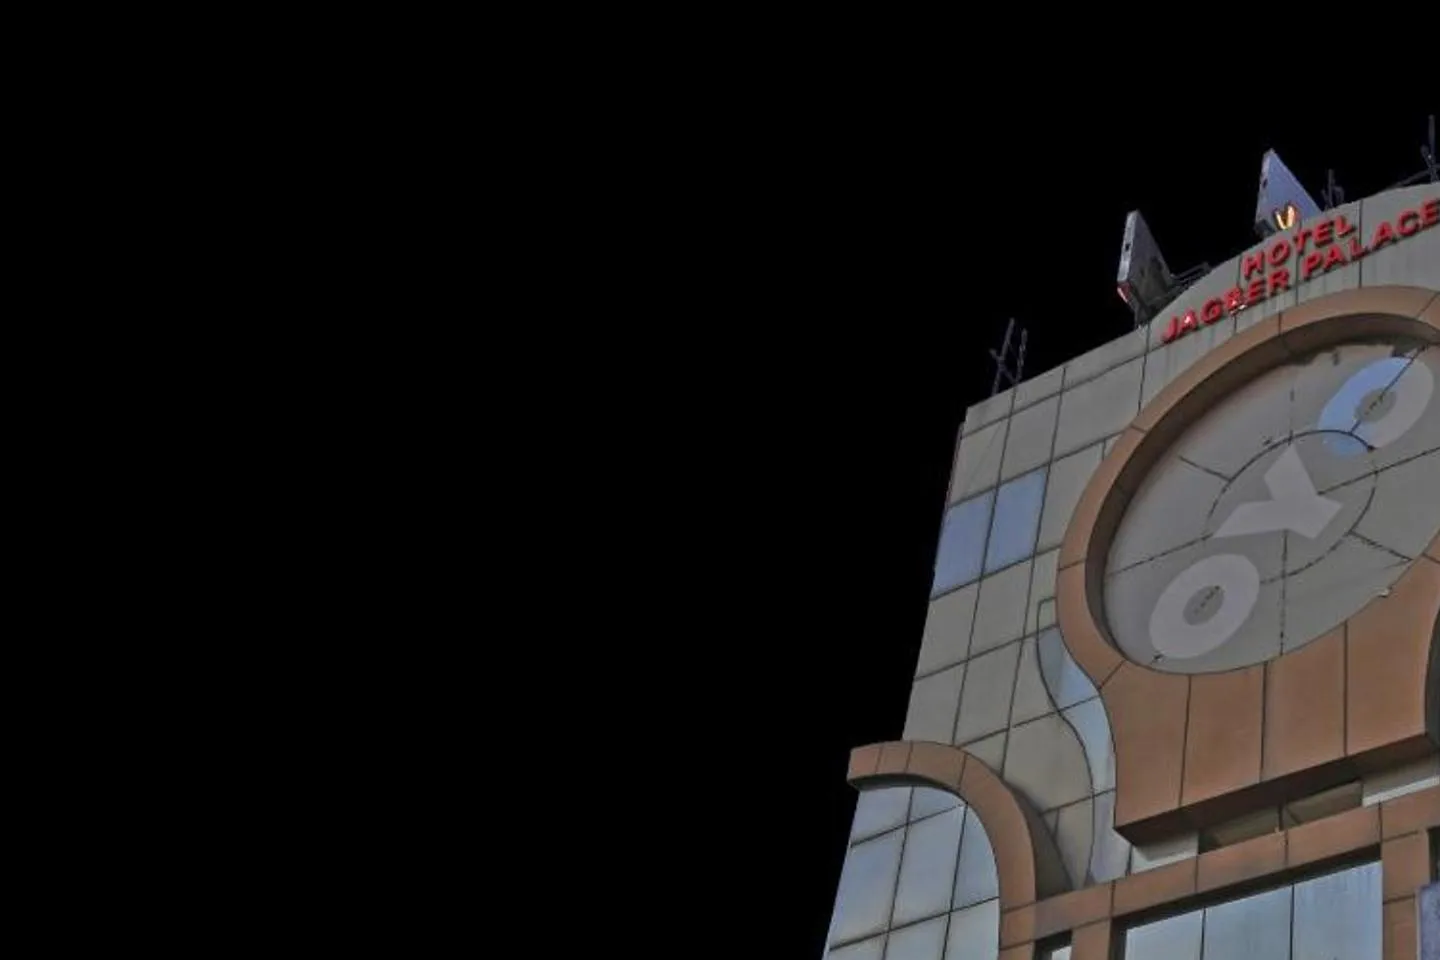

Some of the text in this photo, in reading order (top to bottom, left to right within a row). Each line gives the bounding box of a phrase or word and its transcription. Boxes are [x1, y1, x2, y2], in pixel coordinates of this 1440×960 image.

[1241, 215, 1356, 279] HOTEL
[1162, 270, 1290, 343] JAGEER
[1149, 356, 1434, 659] OYO
